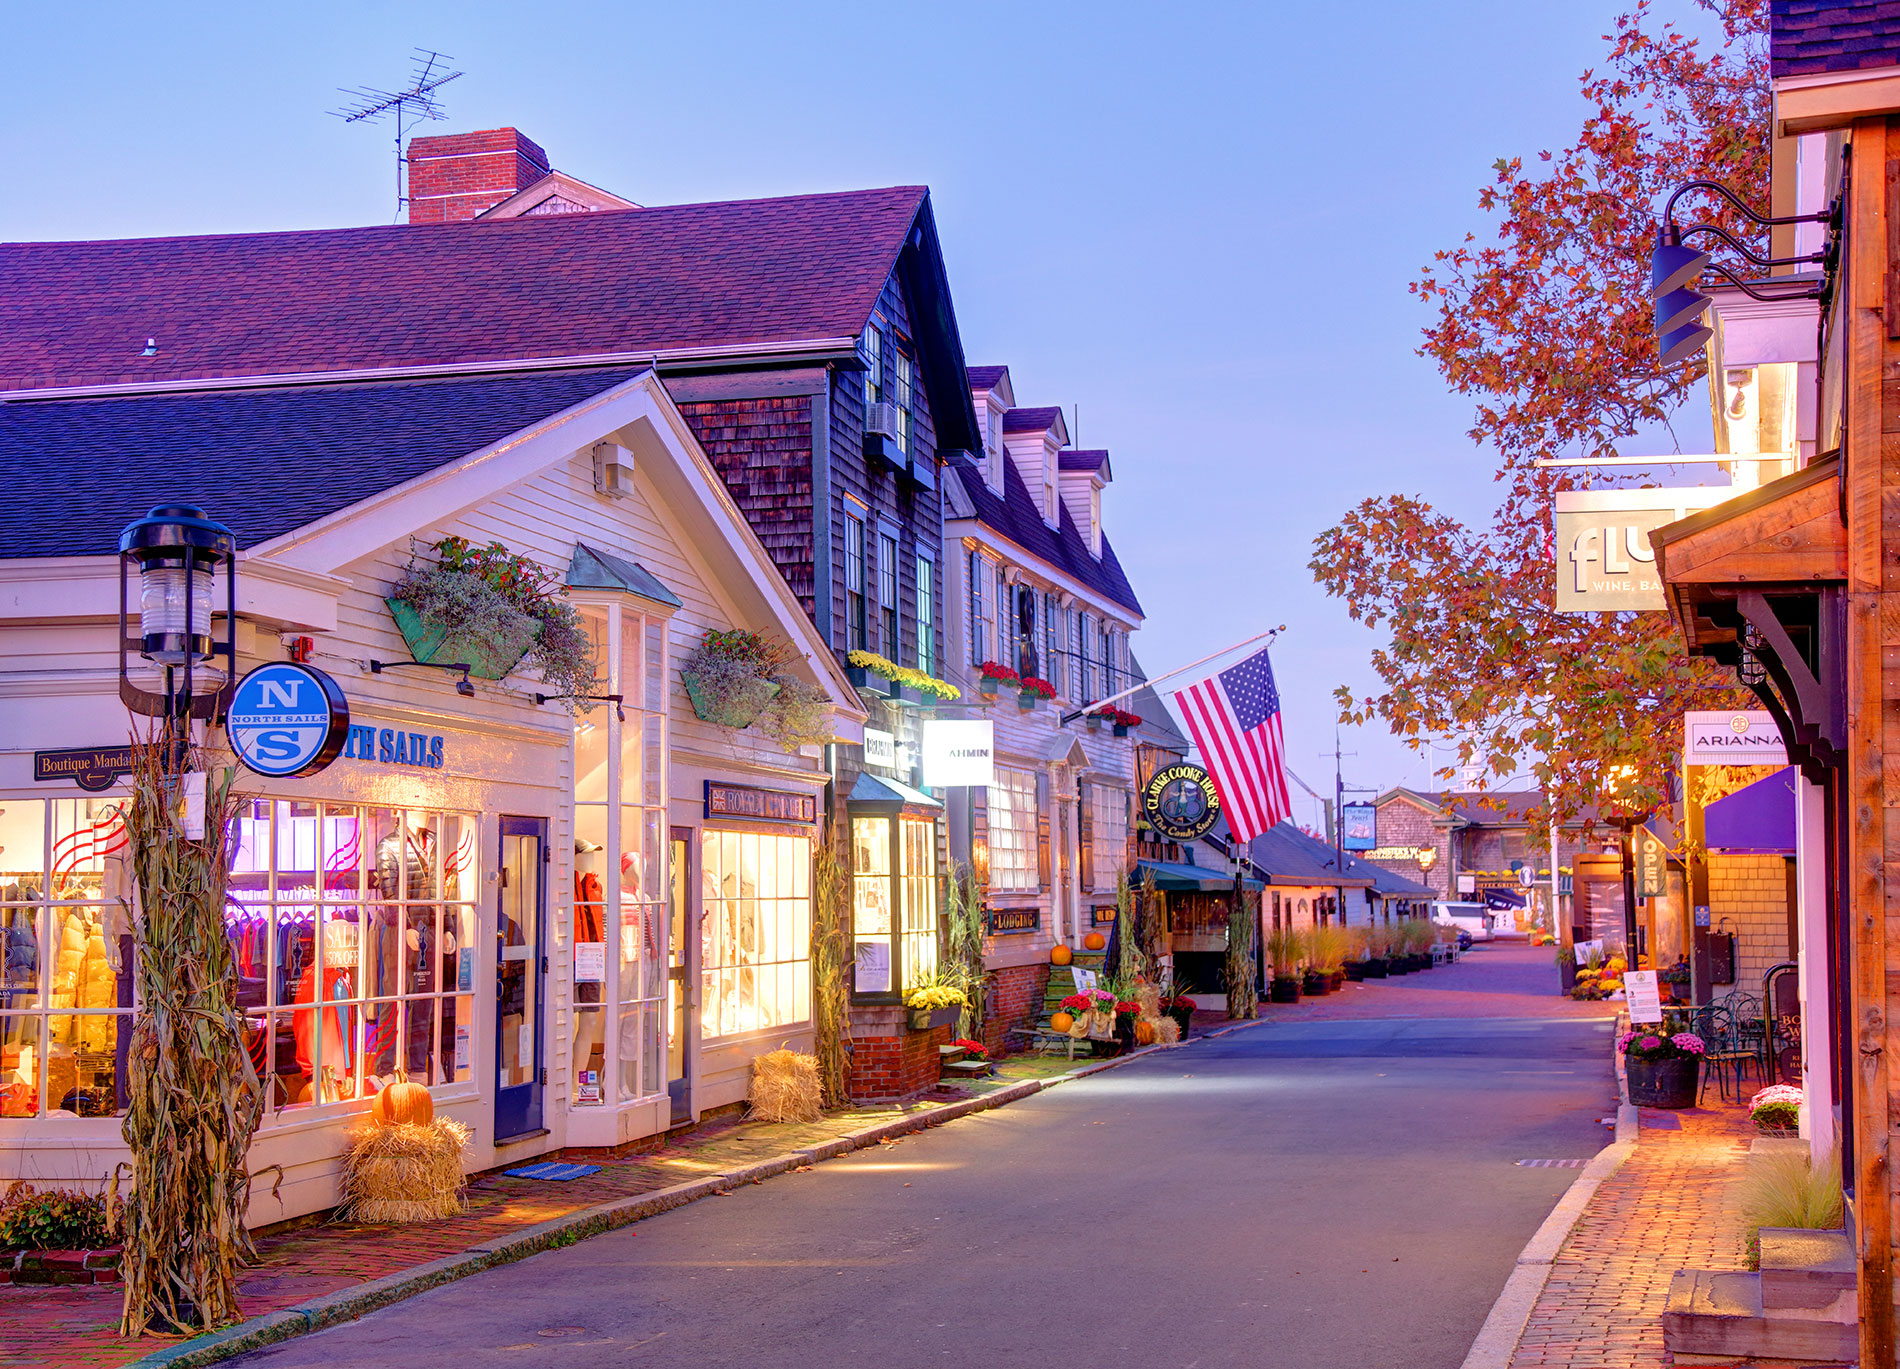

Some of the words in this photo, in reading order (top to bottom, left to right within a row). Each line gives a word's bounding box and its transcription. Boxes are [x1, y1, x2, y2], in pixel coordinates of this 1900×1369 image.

[1640, 579, 1664, 591] BA
[256, 679, 305, 708] N
[232, 715, 281, 724] NORTH
[285, 714, 328, 723] SAILS
[256, 730, 302, 760] S
[380, 728, 445, 770] SAILS
[1696, 735, 1784, 746] ARIANNA
[42, 757, 91, 773] Boutique
[1147, 772, 1171, 810] CLARKE
[1168, 766, 1204, 782] COOKE
[1200, 776, 1220, 809] HOUSE
[727, 791, 759, 813] ROYAL
[1153, 814, 1167, 831] The
[1168, 826, 1195, 838] Candy
[1196, 814, 1215, 834] Store
[1643, 839, 1658, 893] OPEN
[998, 913, 1033, 929] LODGING
[326, 924, 359, 949] SALE
